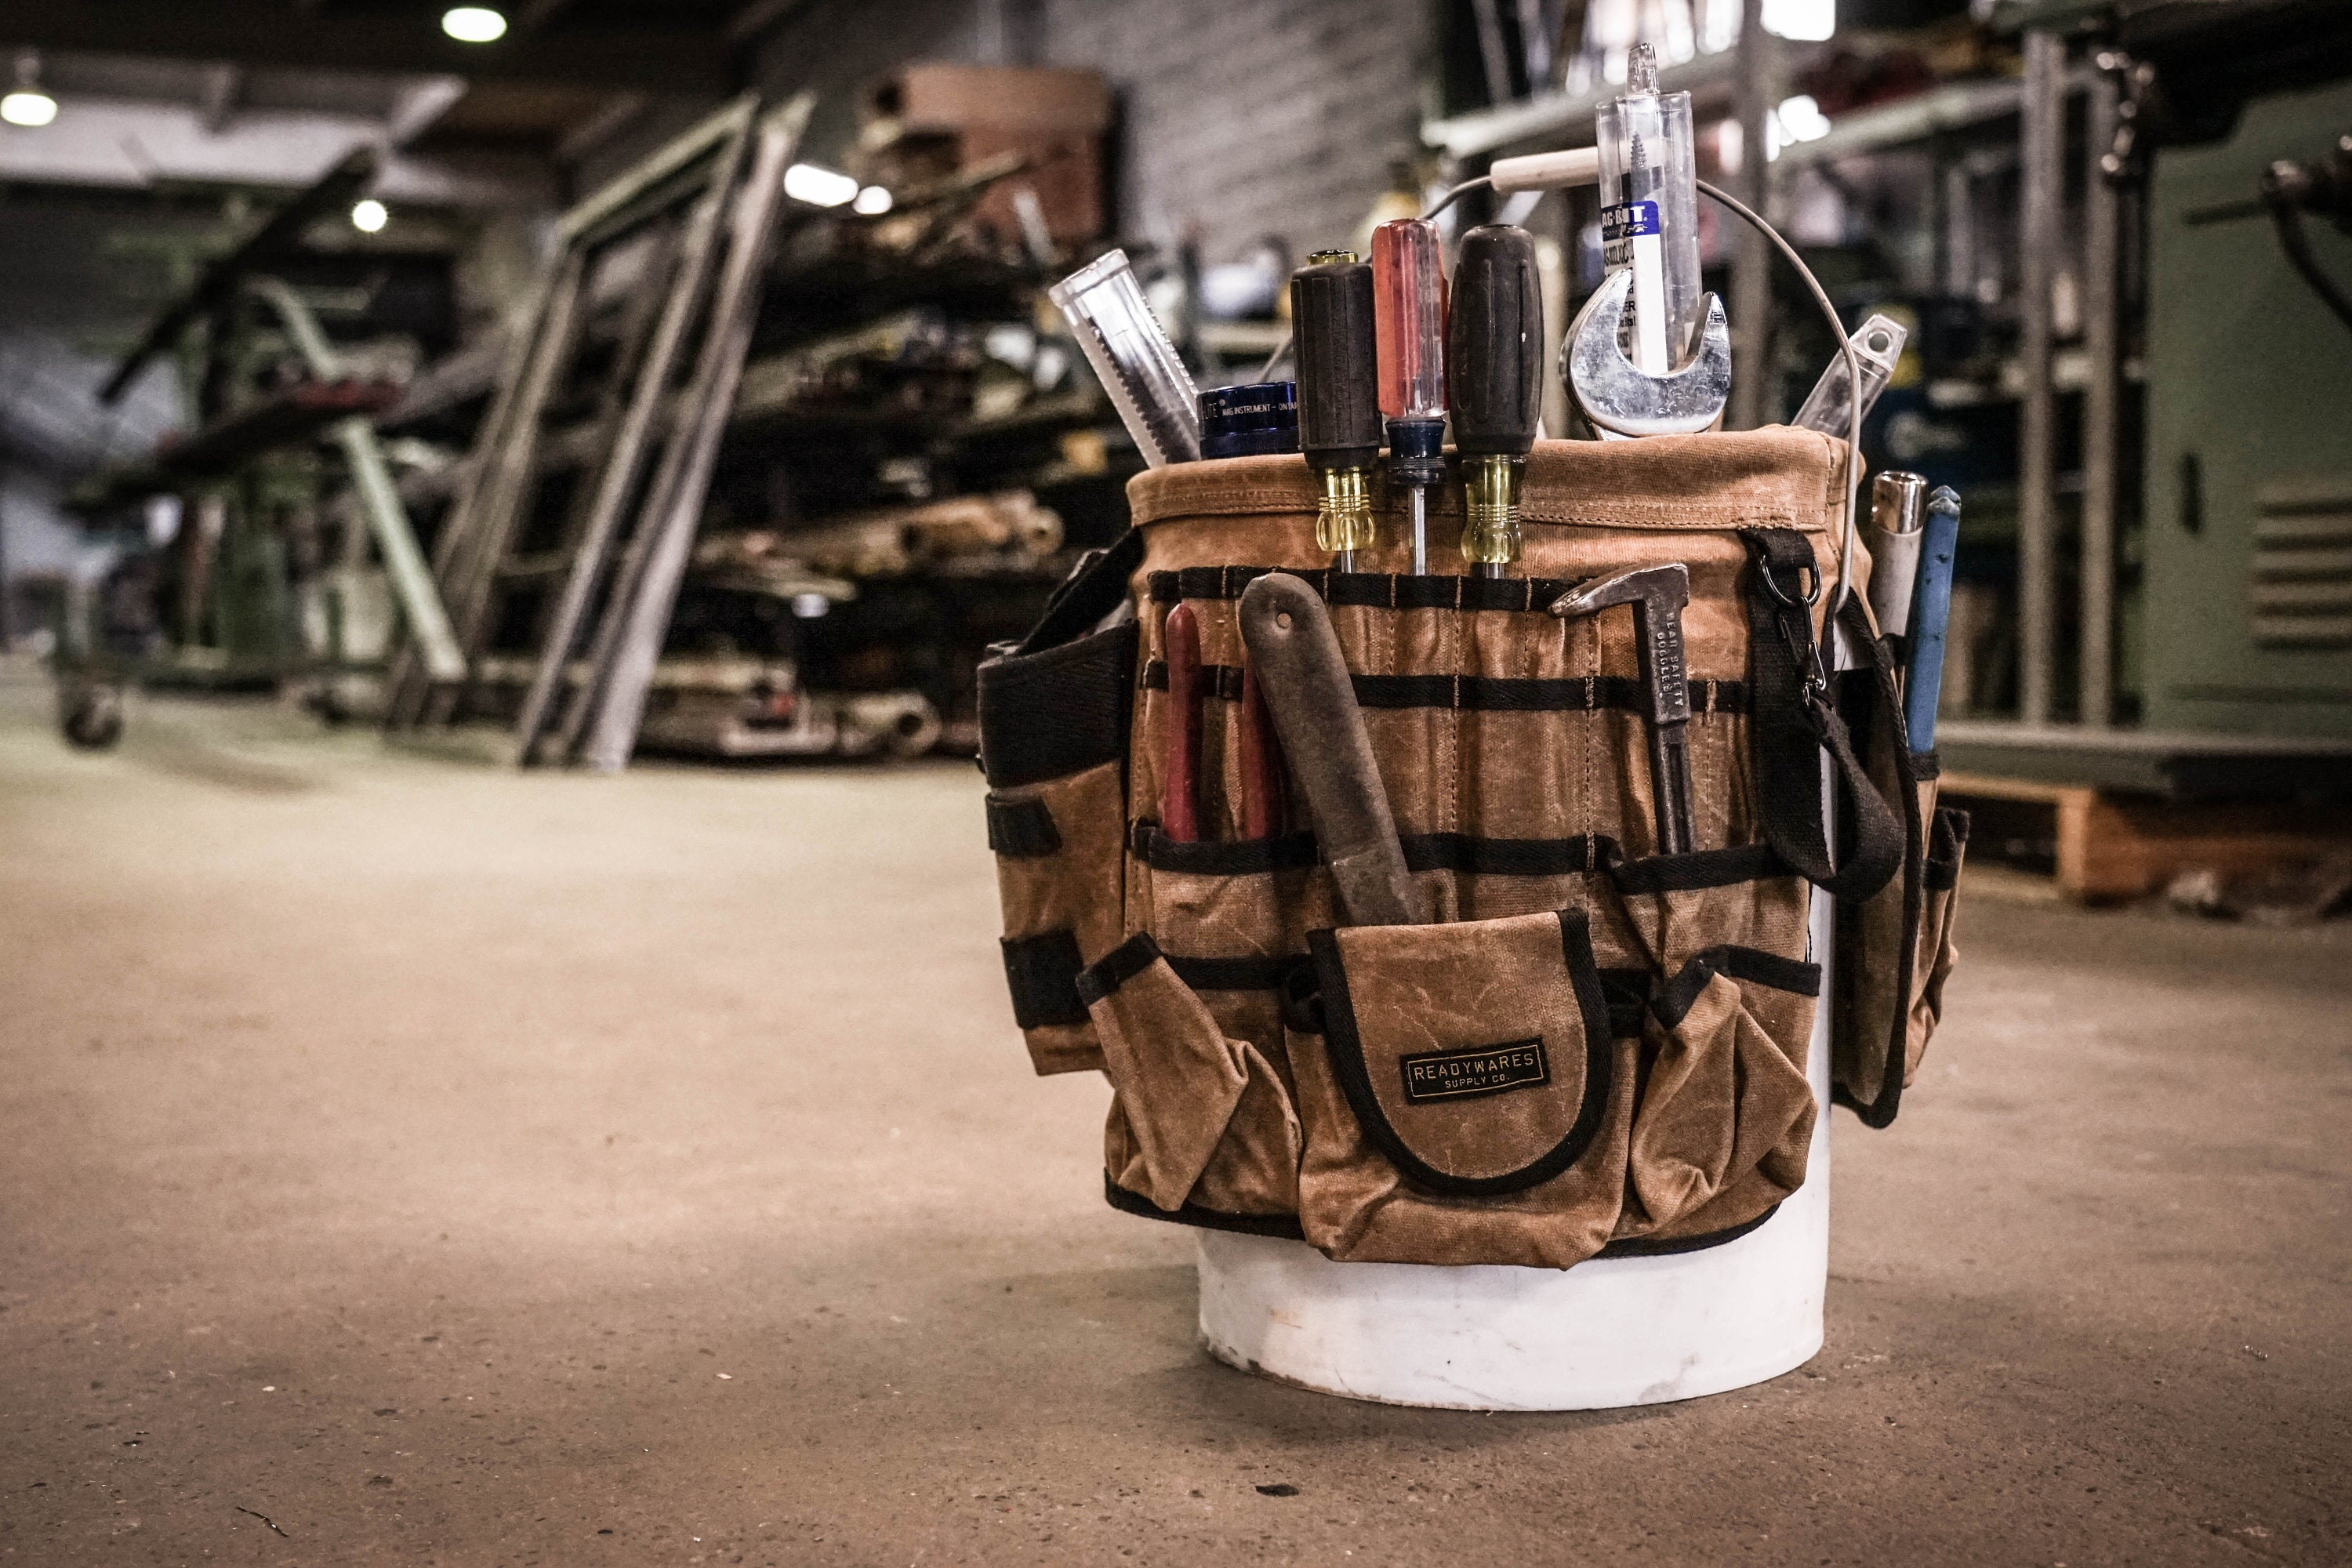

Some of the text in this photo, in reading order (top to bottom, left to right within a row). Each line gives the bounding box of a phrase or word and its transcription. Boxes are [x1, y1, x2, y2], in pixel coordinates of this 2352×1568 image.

[1234, 403, 1271, 415] INSTRUMENT
[1666, 612, 1684, 706] WEAR SAFETY
[1414, 1053, 1534, 1080] READYWARES
[1445, 1073, 1511, 1089] SUPPLY CO.
